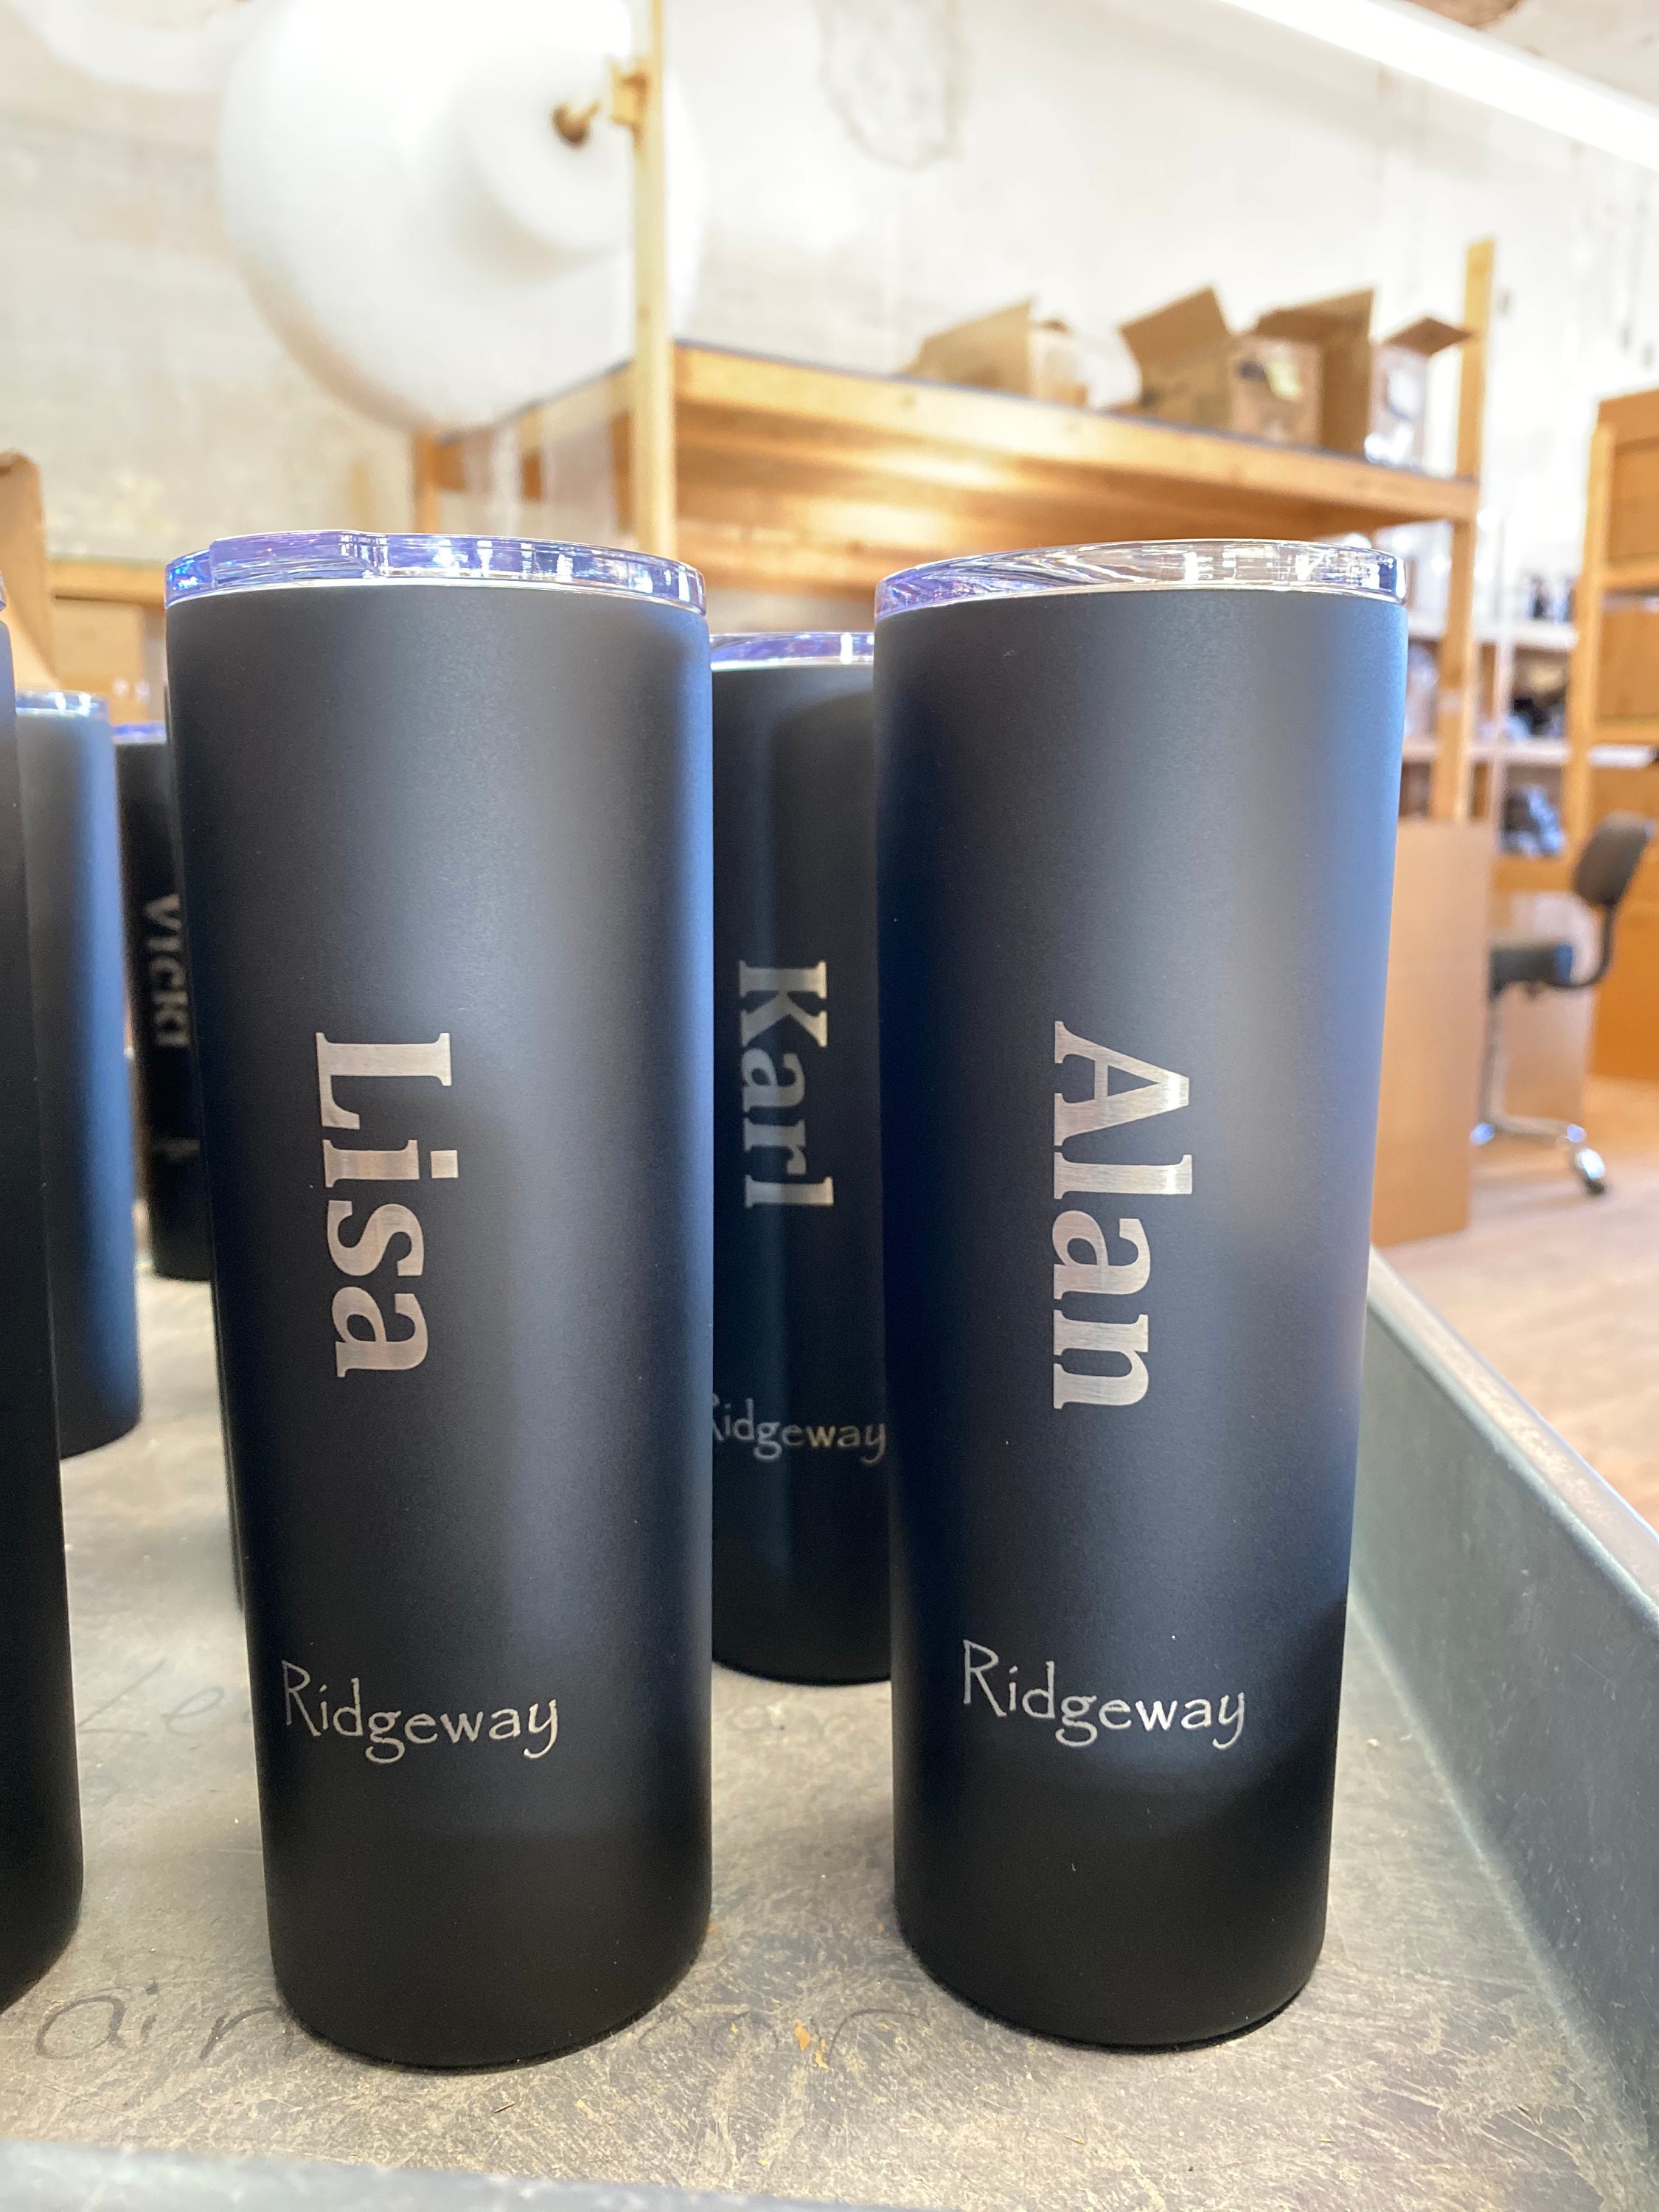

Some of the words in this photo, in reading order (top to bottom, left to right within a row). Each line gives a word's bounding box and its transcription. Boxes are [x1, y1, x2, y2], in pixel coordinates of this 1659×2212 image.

[315, 1032, 459, 1378] Lisa
[739, 960, 833, 1208] Karl
[1051, 1020, 1193, 1410] Alan
[281, 1659, 559, 1764] Ridgeway
[963, 1638, 1245, 1750] Ridgeway
